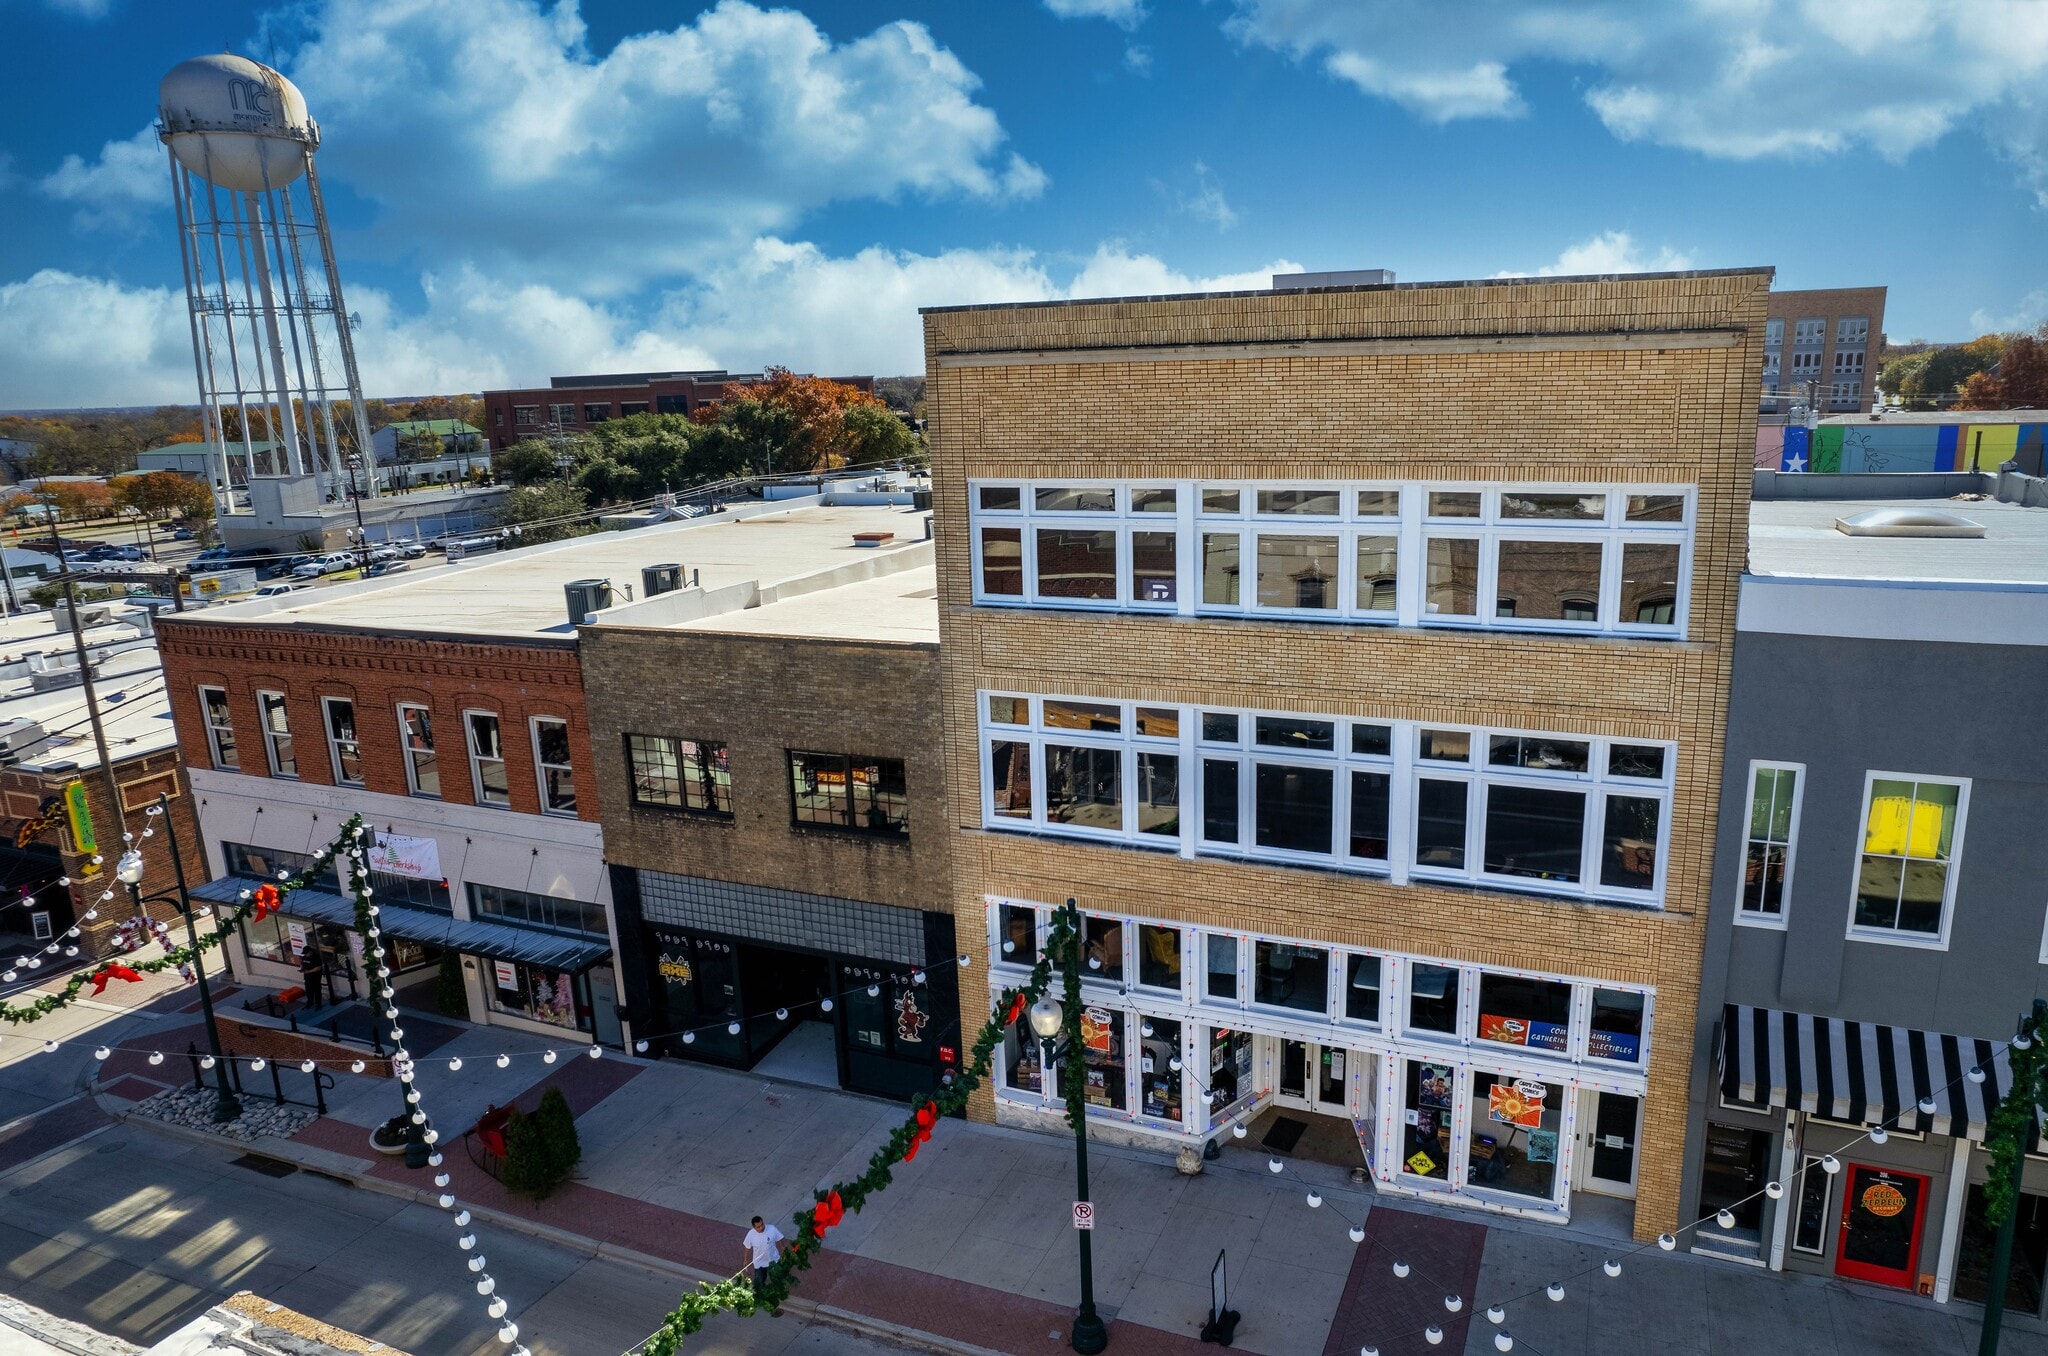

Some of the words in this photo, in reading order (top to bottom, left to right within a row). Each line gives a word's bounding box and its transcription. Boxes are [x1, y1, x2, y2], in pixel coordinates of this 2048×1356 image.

[660, 965, 690, 979] AXE
[1589, 1032, 1612, 1041] AMES
[1588, 1042, 1633, 1055] OLLECTIBLES
[1518, 1081, 1532, 1089] CARPE
[1521, 1087, 1539, 1095] COMICS
[1873, 1191, 1892, 1199] RED
[1861, 1198, 1906, 1207] ZEPPELIN
